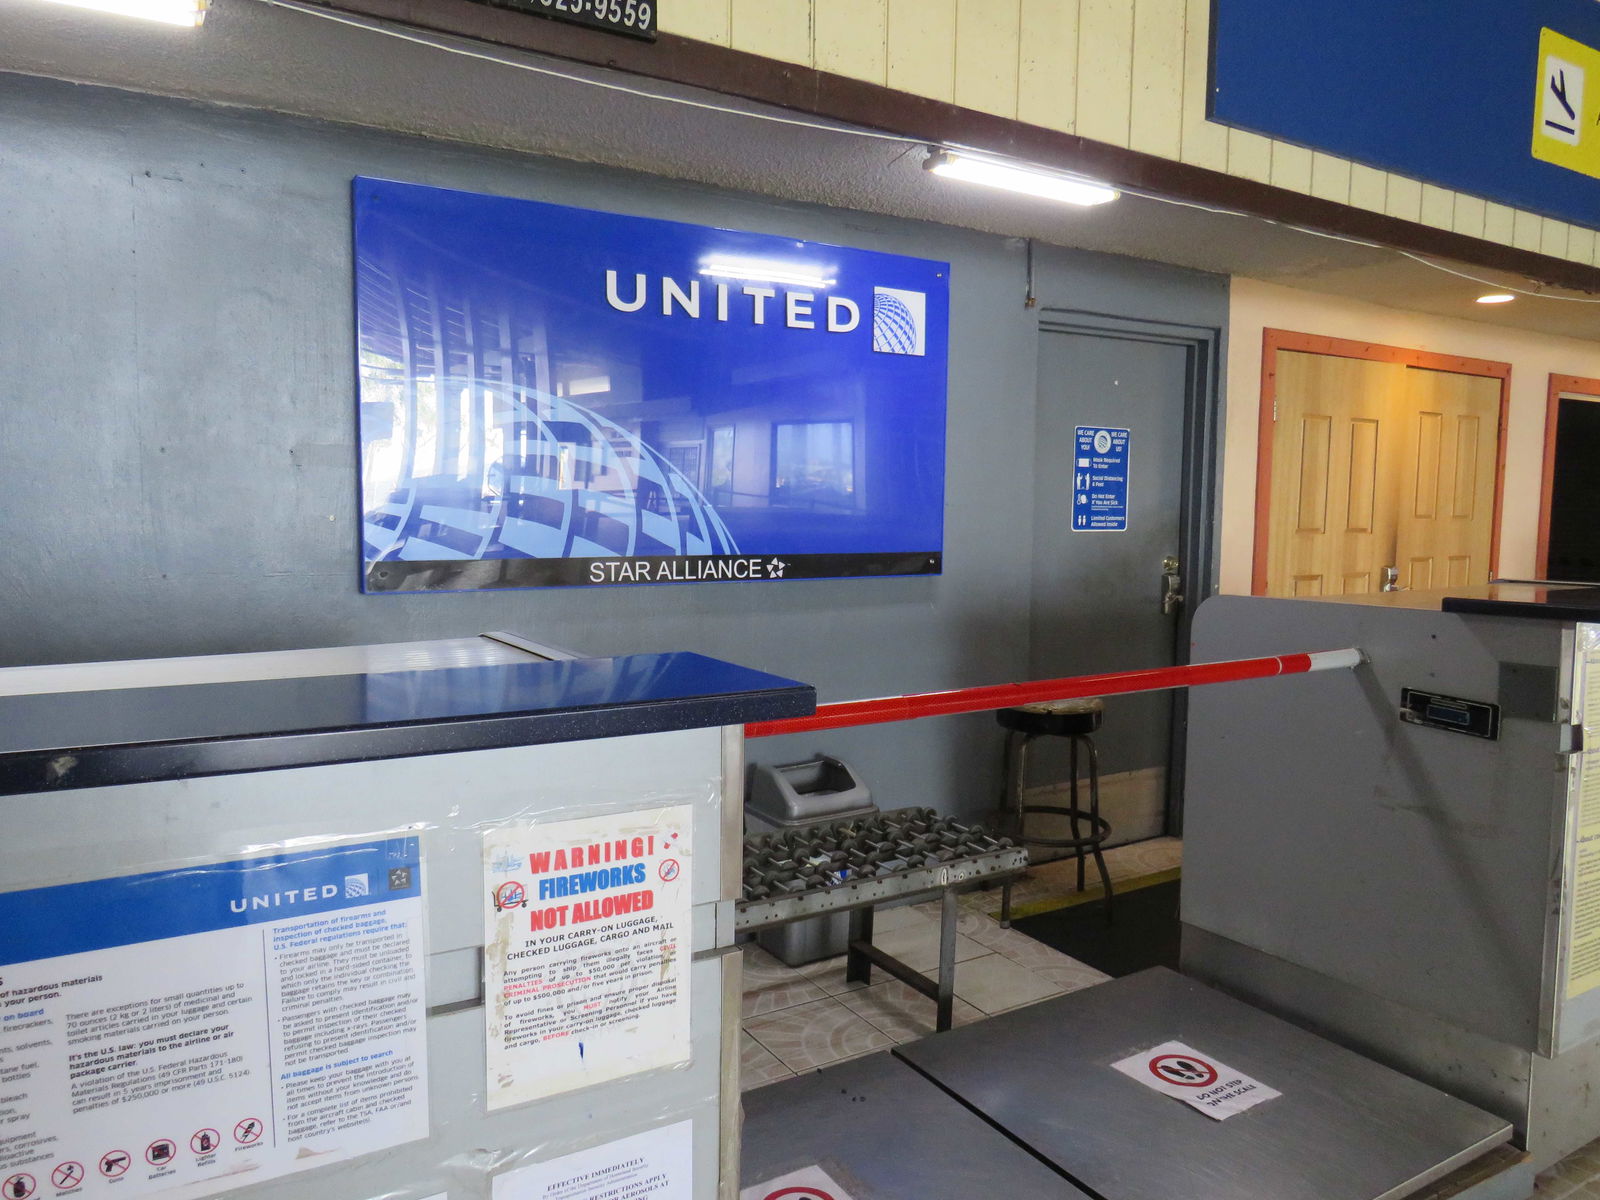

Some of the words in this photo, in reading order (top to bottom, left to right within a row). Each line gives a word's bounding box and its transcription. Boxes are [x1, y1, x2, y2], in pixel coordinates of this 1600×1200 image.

[540, 0, 651, 30] 5-9559
[606, 270, 860, 333] UNITED
[590, 562, 651, 582] STAR
[656, 559, 762, 580] ALLIANCE
[530, 835, 654, 874] WARNING!
[539, 862, 646, 900] FIREWORKS
[230, 884, 338, 913] UNITED
[531, 906, 568, 932] NOT
[572, 890, 654, 925] ALLOWED
[272, 920, 329, 934] Transportation
[340, 913, 372, 923] firearms
[290, 937, 318, 948] Federal
[320, 930, 360, 943] regulations
[363, 926, 388, 936] require
[324, 922, 353, 933] checked
[540, 934, 565, 944] YOUR
[568, 924, 614, 939] CARRY-ON
[616, 916, 658, 930] LUGGAGE,
[507, 947, 550, 960] CHECKED
[554, 938, 597, 952] LUGGAGE,
[600, 931, 630, 942] CARGO
[632, 927, 650, 935] AND
[653, 922, 674, 932] MAIL
[4, 997, 25, 1007] your
[28, 992, 61, 1003] person.
[12, 983, 59, 996] hazardous
[61, 975, 102, 988] materials
[17, 1008, 44, 1019] board
[66, 1012, 89, 1020] There
[106, 1001, 148, 1014] exceptions
[164, 994, 184, 1002] small
[186, 987, 223, 999] quantities
[80, 1017, 107, 1026] ounces
[184, 995, 220, 1006] medicinal
[70, 1056, 114, 1070] hazardous
[117, 1047, 156, 1060] materials
[184, 1036, 211, 1047] airline
[84, 1050, 98, 1058] the
[101, 1047, 116, 1055] U.S.
[139, 1040, 154, 1048] you
[157, 1035, 176, 1044] must
[179, 1029, 208, 1039] declare
[211, 1024, 229, 1033] your
[70, 1067, 105, 1079] package
[108, 1060, 138, 1071] carrier.
[293, 1066, 323, 1078] baggage
[334, 1058, 359, 1069] subject
[370, 1050, 393, 1060] search
[547, 1175, 589, 1192] EFFECTIVE
[591, 1157, 644, 1178] IMMEDIATELY
[646, 1173, 666, 1185] APPLY
